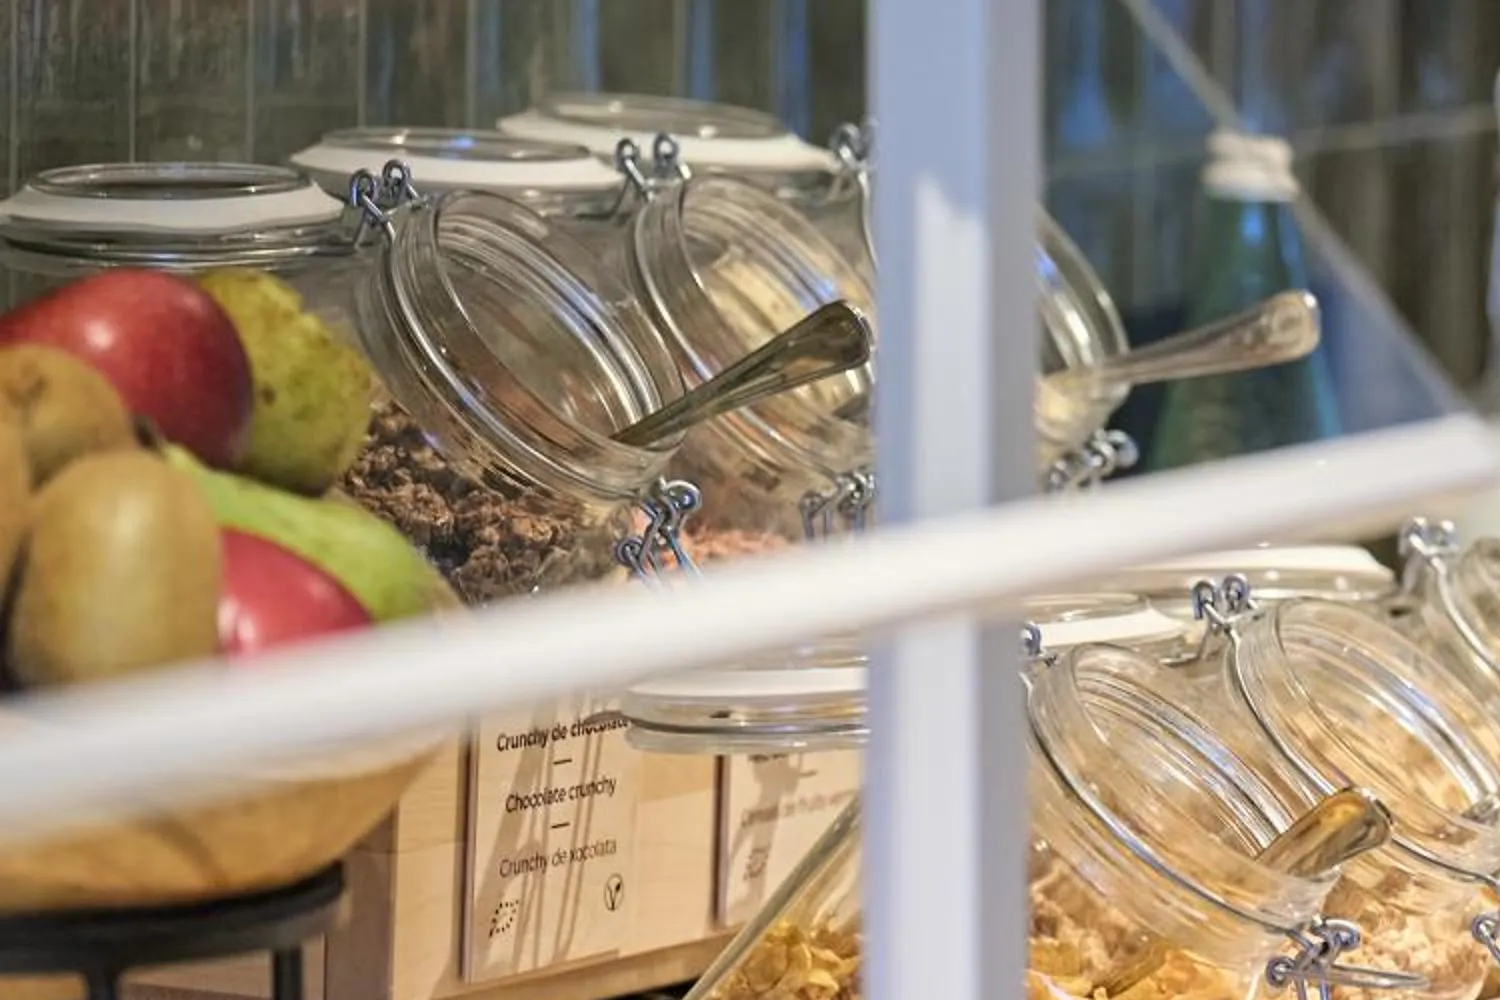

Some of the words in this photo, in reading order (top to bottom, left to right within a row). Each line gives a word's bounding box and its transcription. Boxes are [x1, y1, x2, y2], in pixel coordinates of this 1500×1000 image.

[497, 727, 549, 751] Crunchy
[551, 721, 568, 741] de
[505, 786, 567, 813] Chocolate
[568, 777, 616, 801] crunchy
[499, 850, 548, 878] Crunchy
[551, 847, 568, 867] de
